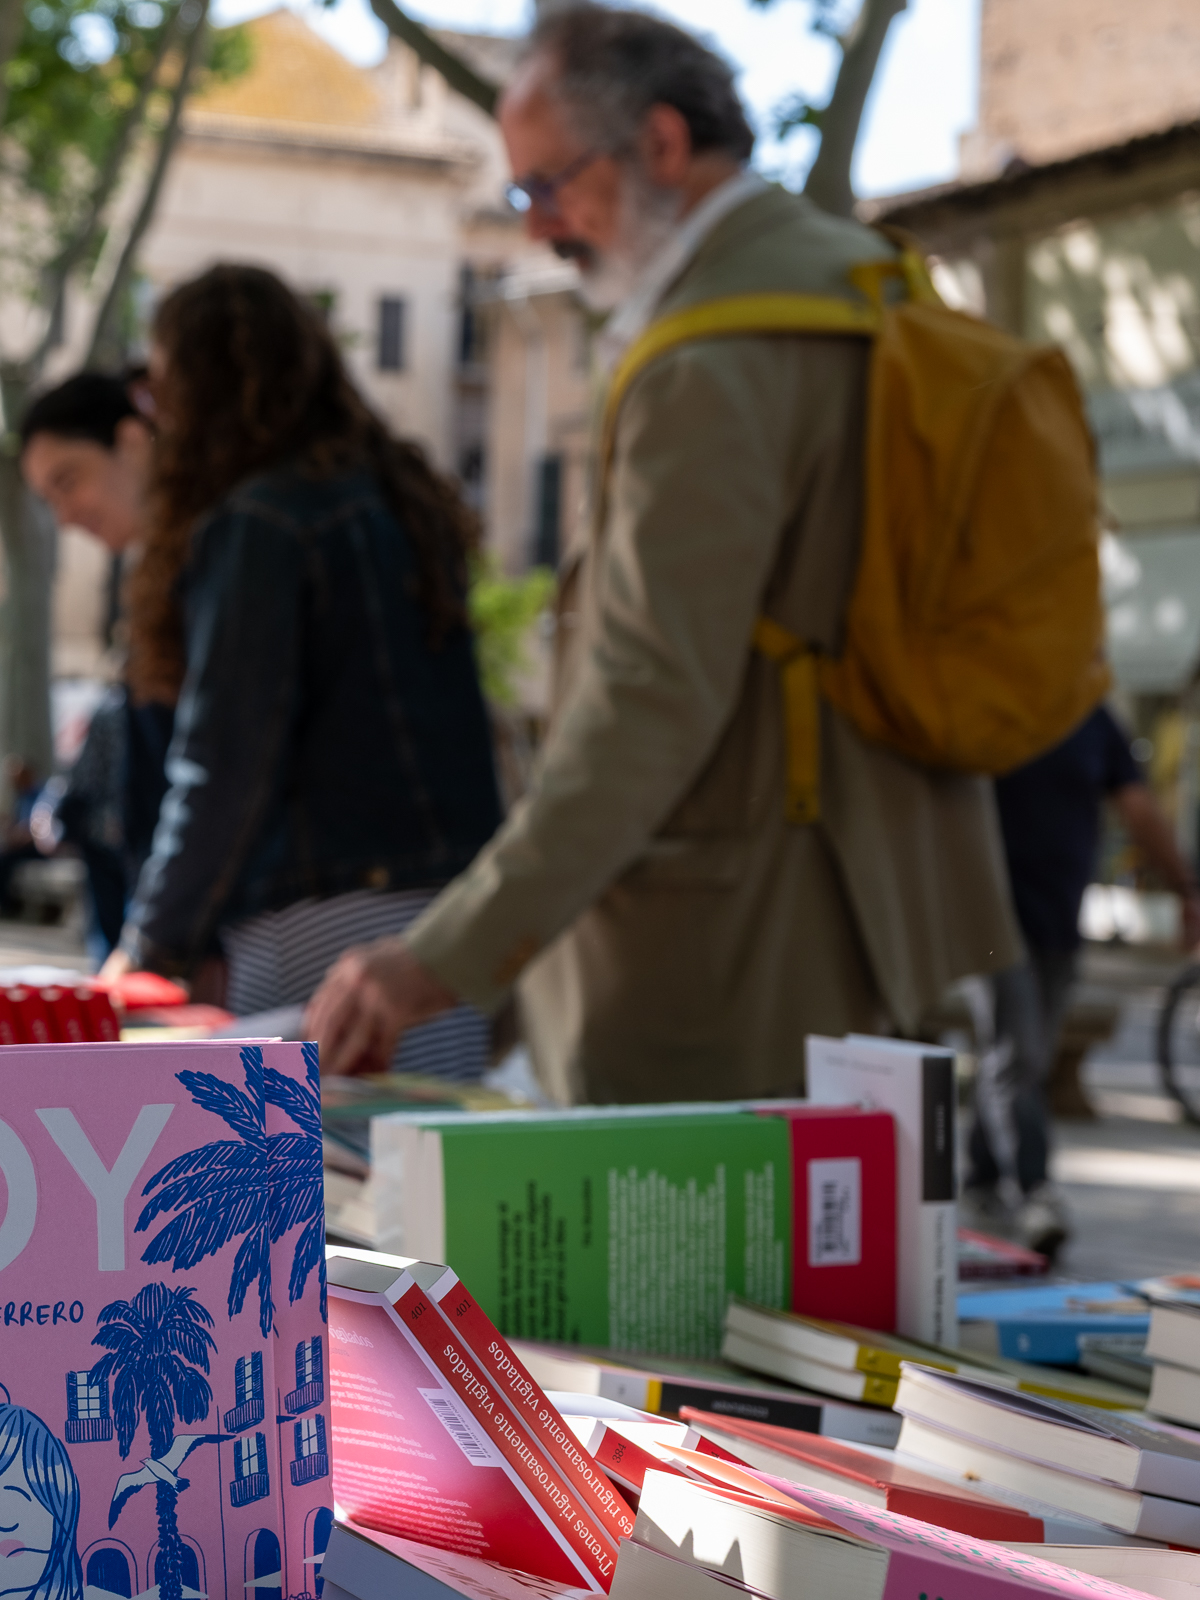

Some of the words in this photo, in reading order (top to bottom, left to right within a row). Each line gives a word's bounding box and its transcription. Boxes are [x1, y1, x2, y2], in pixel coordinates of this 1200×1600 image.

[411, 1302, 428, 1321] 401
[455, 1299, 472, 1318] 401
[443, 1344, 495, 1415] vigilados
[488, 1341, 539, 1412] vigilados
[494, 1412, 578, 1523] rigurosamente
[538, 1409, 621, 1519] rigurosamente
[612, 1442, 627, 1464] 384
[573, 1519, 614, 1577] Trenes
